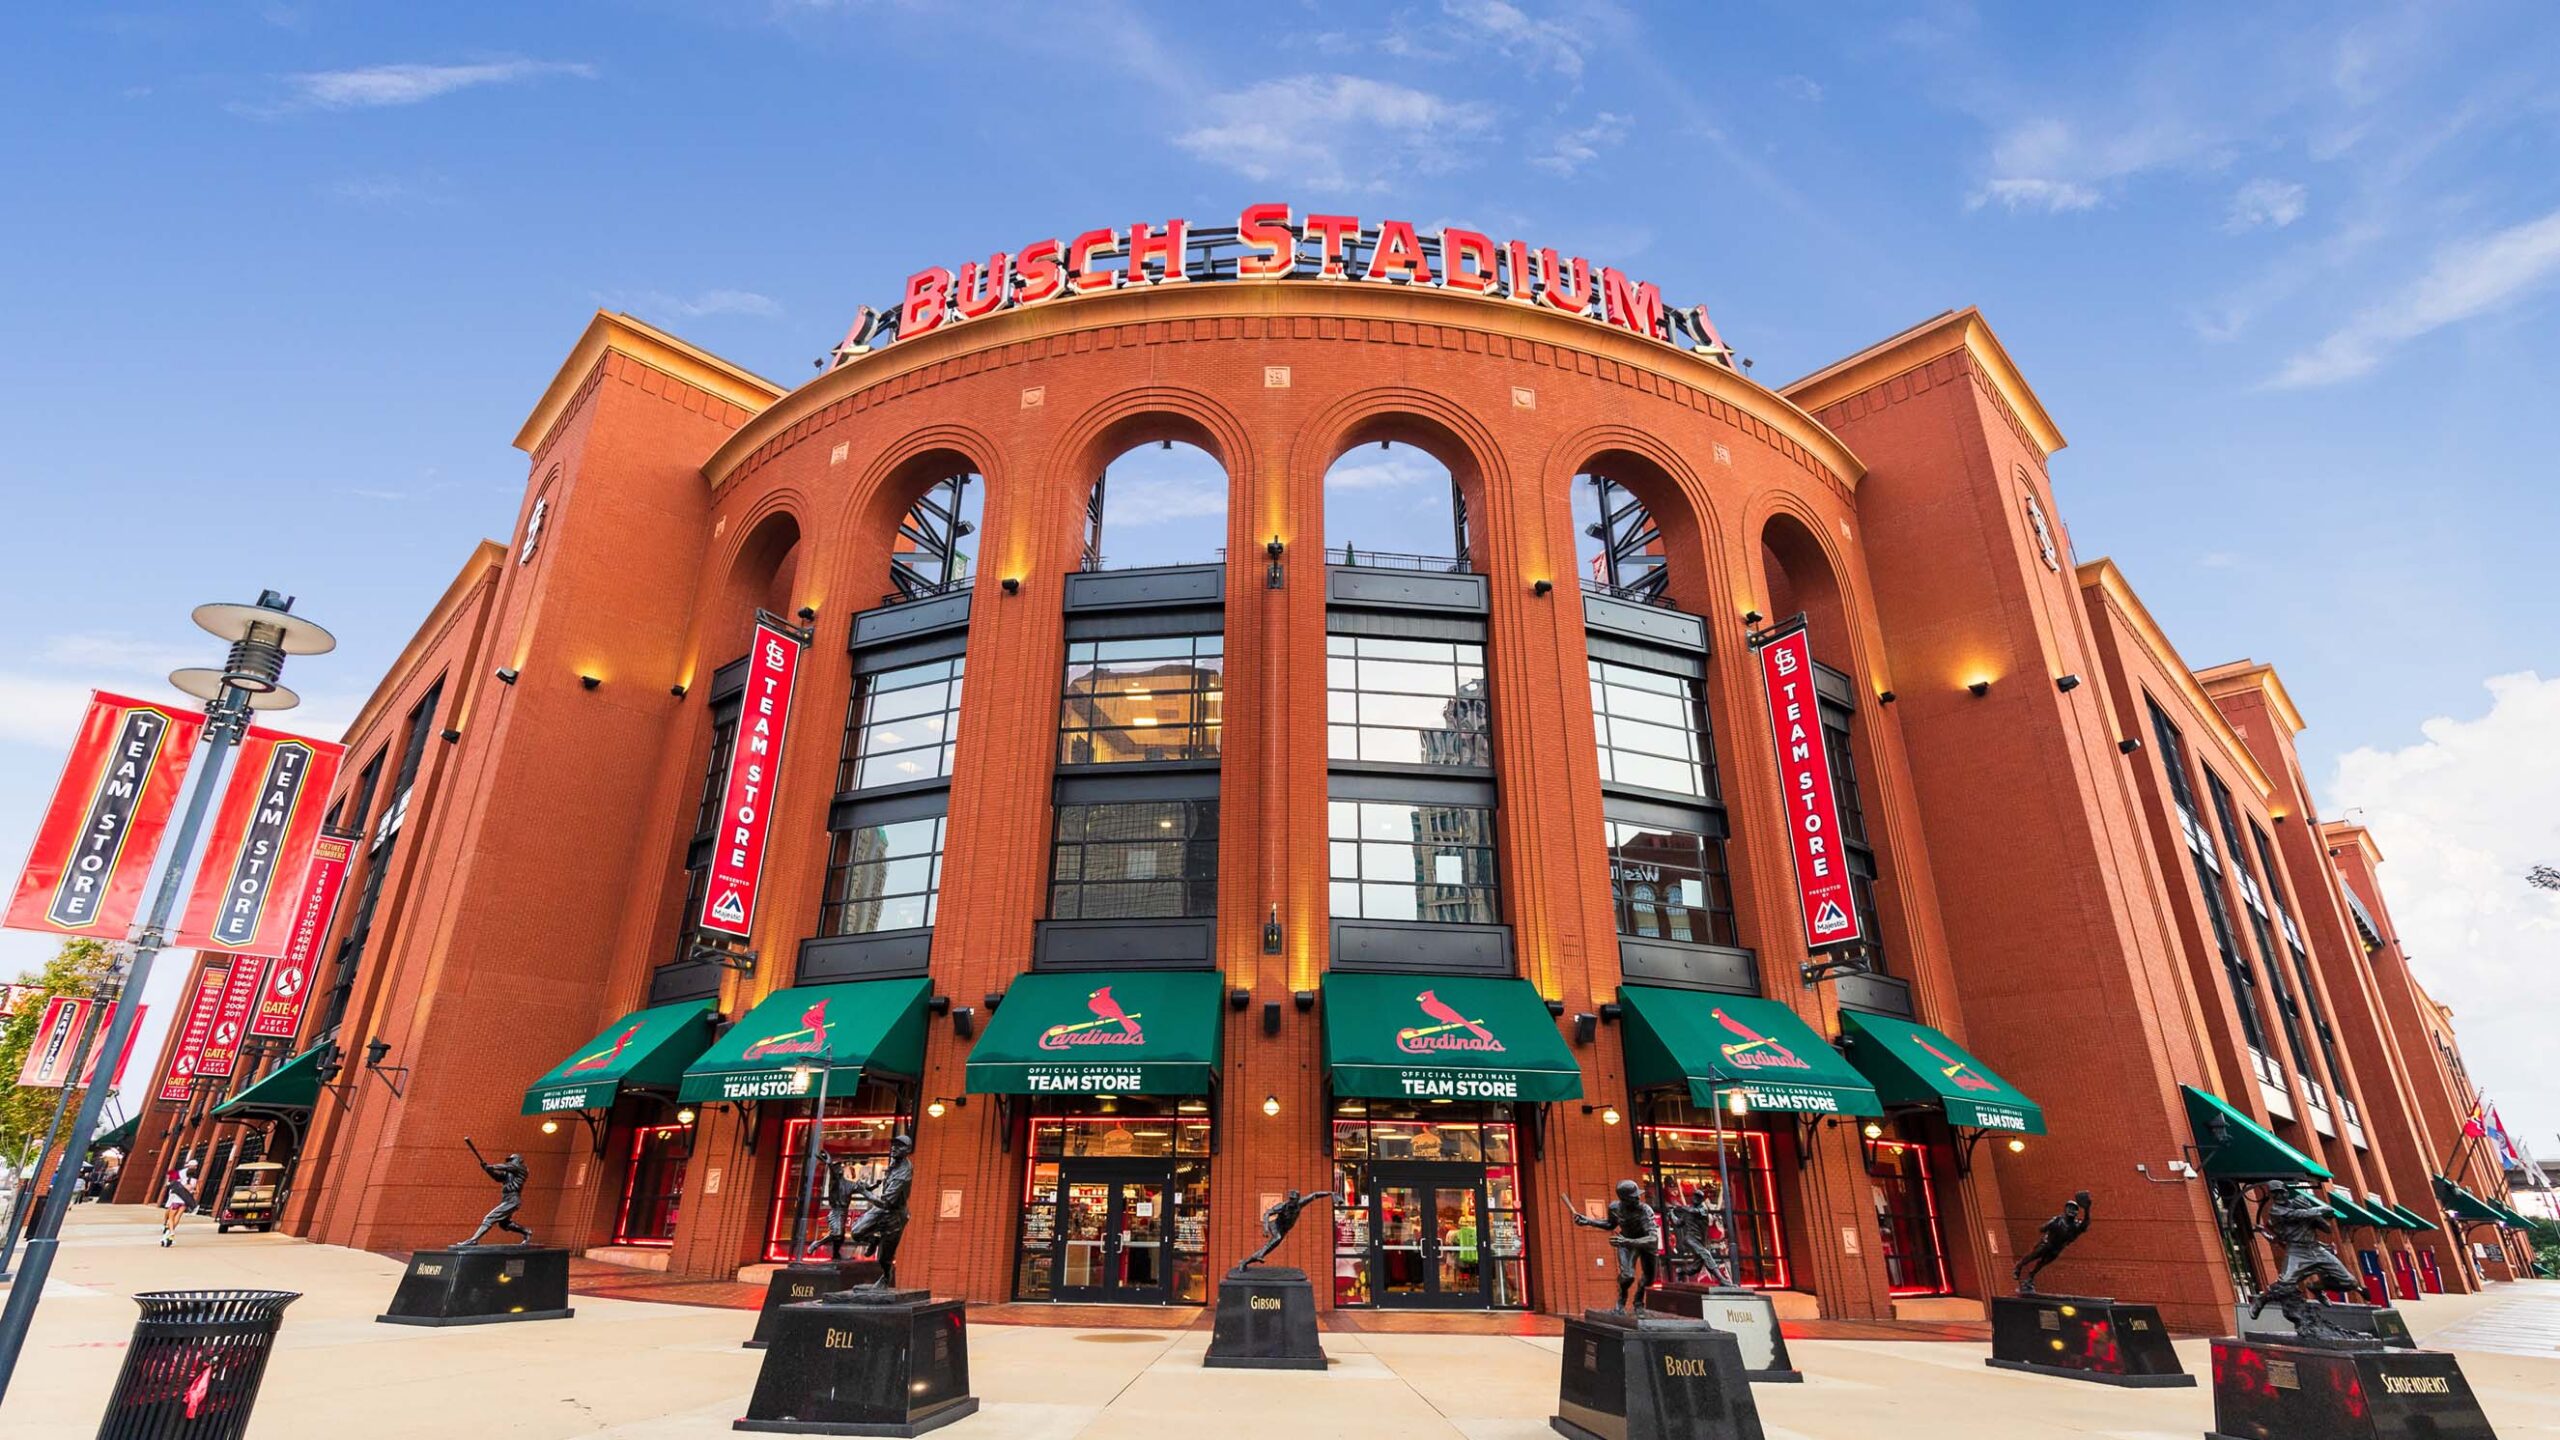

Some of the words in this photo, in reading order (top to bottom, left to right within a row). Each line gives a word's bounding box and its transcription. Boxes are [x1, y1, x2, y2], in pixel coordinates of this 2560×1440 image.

[897, 217, 1192, 341] BUSCH
[1236, 202, 1668, 342] STADIUM
[751, 676, 778, 756] TEAM
[107, 720, 154, 799] TEAM
[1783, 682, 1809, 763] TEAM
[1800, 771, 1829, 877] STORE
[260, 752, 300, 826] TEAM
[731, 764, 762, 868] STORE
[66, 813, 117, 914] STORE
[228, 840, 270, 934] STORE
[306, 911, 317, 919] 17
[309, 903, 319, 911] 14
[714, 908, 742, 921] Majestic
[300, 927, 312, 935] 24
[302, 919, 315, 927] 20
[1816, 920, 1846, 932] Majestic
[262, 1001, 290, 1015] GATE
[291, 1003, 300, 1016] 4
[55, 1005, 75, 1038] TEAM
[260, 1025, 288, 1033] FIELD
[1039, 1024, 1145, 1050] Cardinals
[1396, 1027, 1506, 1054] Cardinals
[204, 1047, 227, 1059] GATE
[227, 1049, 234, 1059] 4
[1721, 1044, 1811, 1070] Cardinals
[168, 1077, 187, 1086] GATE
[764, 1073, 793, 1081] CARDIN
[1027, 1075, 1078, 1090] TEAM
[1080, 1075, 1141, 1090] STORE
[1401, 1071, 1452, 1079] OFFICIAL
[1458, 1072, 1517, 1081] CARDINALS
[723, 1082, 760, 1098] TEAM
[1401, 1079, 1454, 1095] TEAM
[1456, 1080, 1518, 1097] STORE
[1788, 1088, 1833, 1097] CARDINALS
[541, 1097, 561, 1111] TEAM
[559, 1094, 587, 1109] STORE
[1747, 1093, 1792, 1109] TEAM
[1790, 1095, 1839, 1112] STORE
[1976, 1112, 2002, 1127] TEAM
[2000, 1115, 2026, 1131] STORE
[790, 1282, 815, 1298] SISLER
[1250, 1295, 1281, 1310] GIBSON
[825, 1327, 854, 1349] BELL
[1665, 1355, 1707, 1377] BROCK
[2380, 1373, 2450, 1394] SCHOENDIENST
